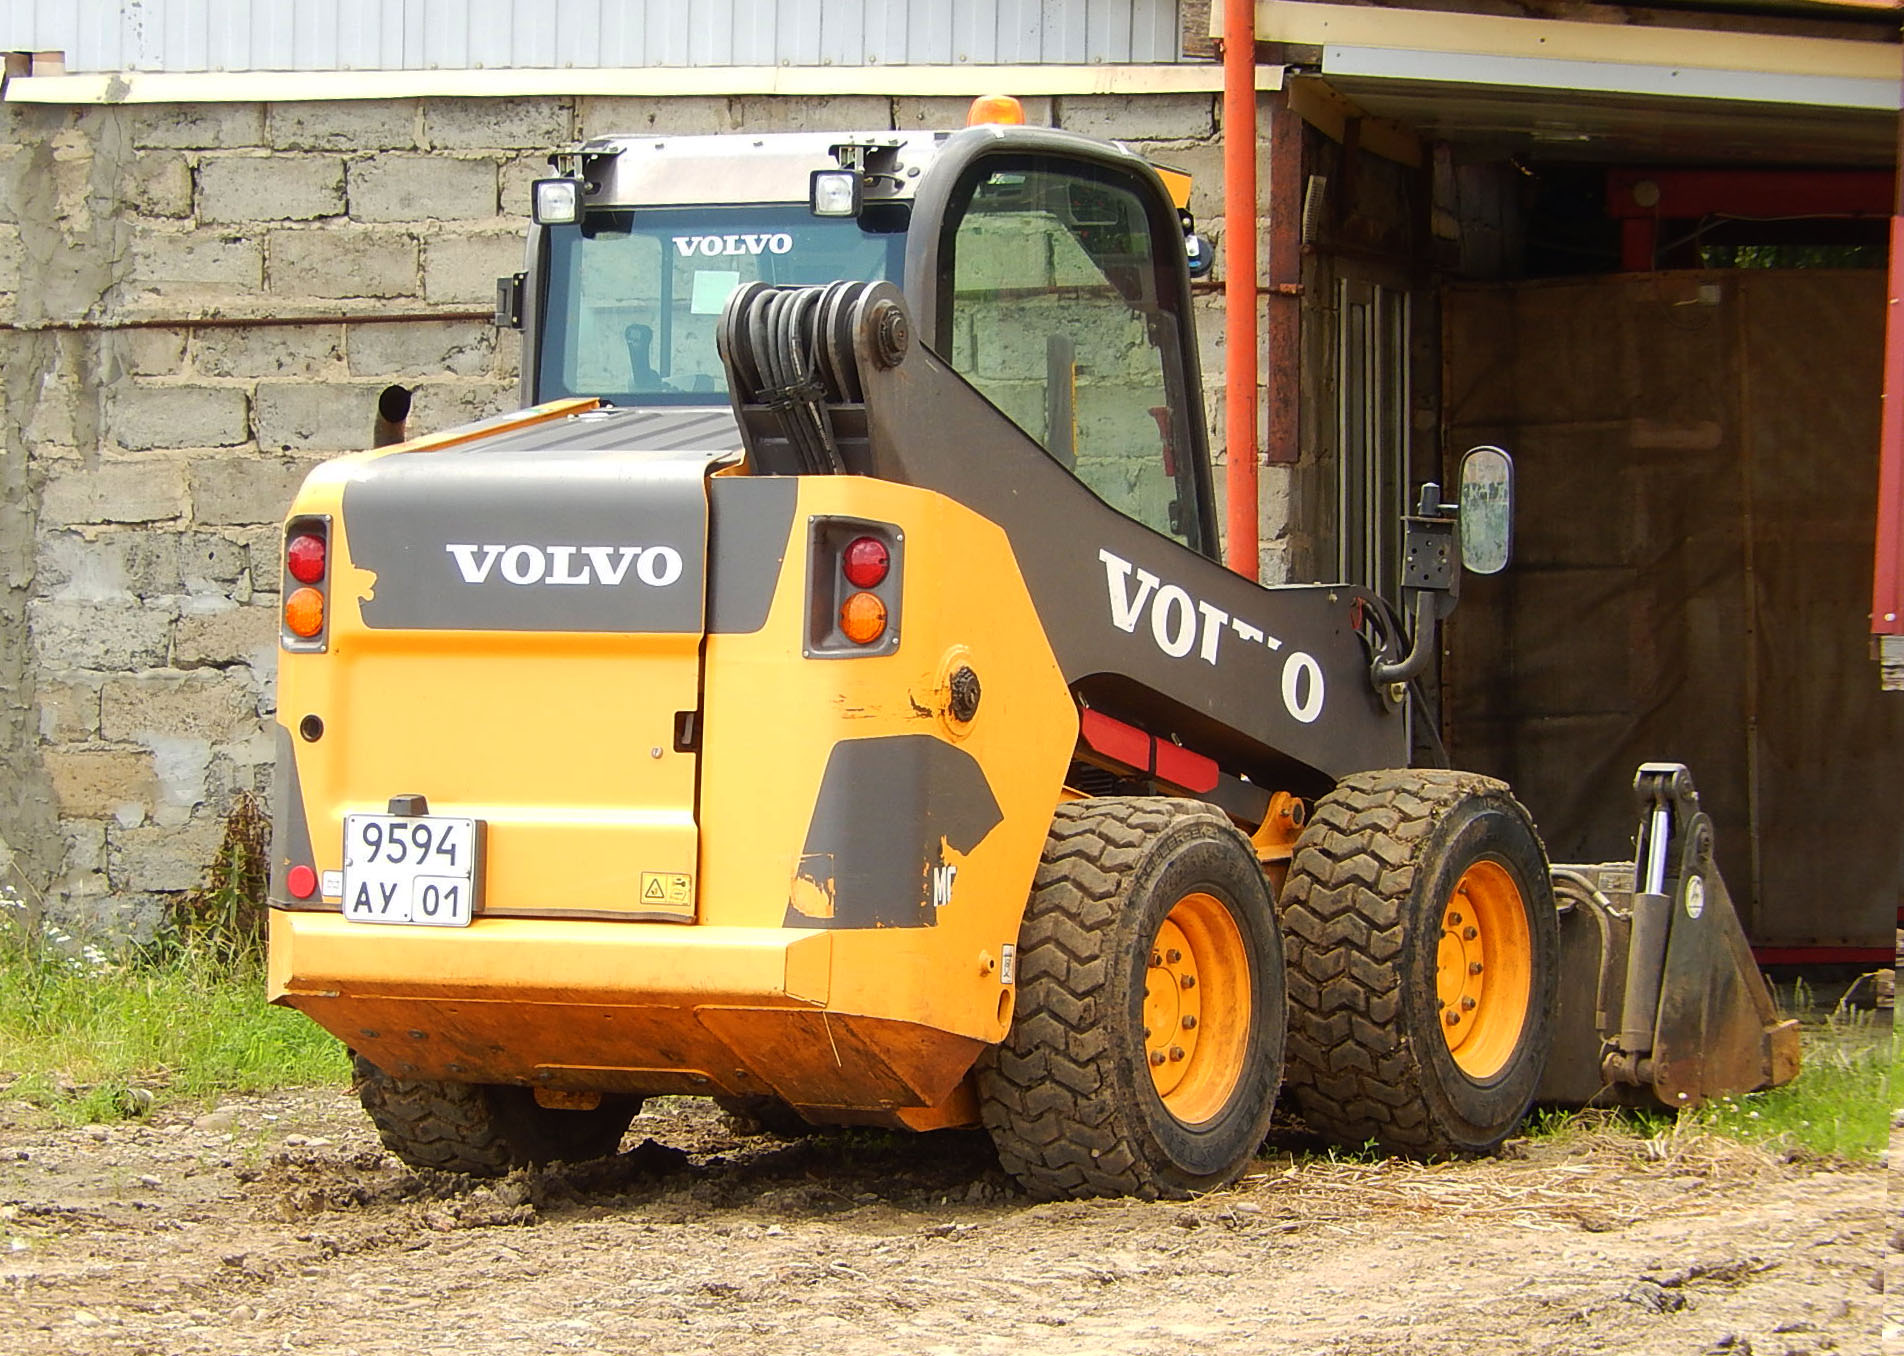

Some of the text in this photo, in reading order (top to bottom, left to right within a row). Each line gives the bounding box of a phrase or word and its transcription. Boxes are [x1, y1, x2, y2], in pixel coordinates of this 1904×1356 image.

[672, 233, 793, 257] VOLVO
[446, 544, 683, 586] VOLVO
[1099, 548, 1325, 723] VOLO
[363, 822, 456, 866] 9594
[423, 884, 459, 917] 01
